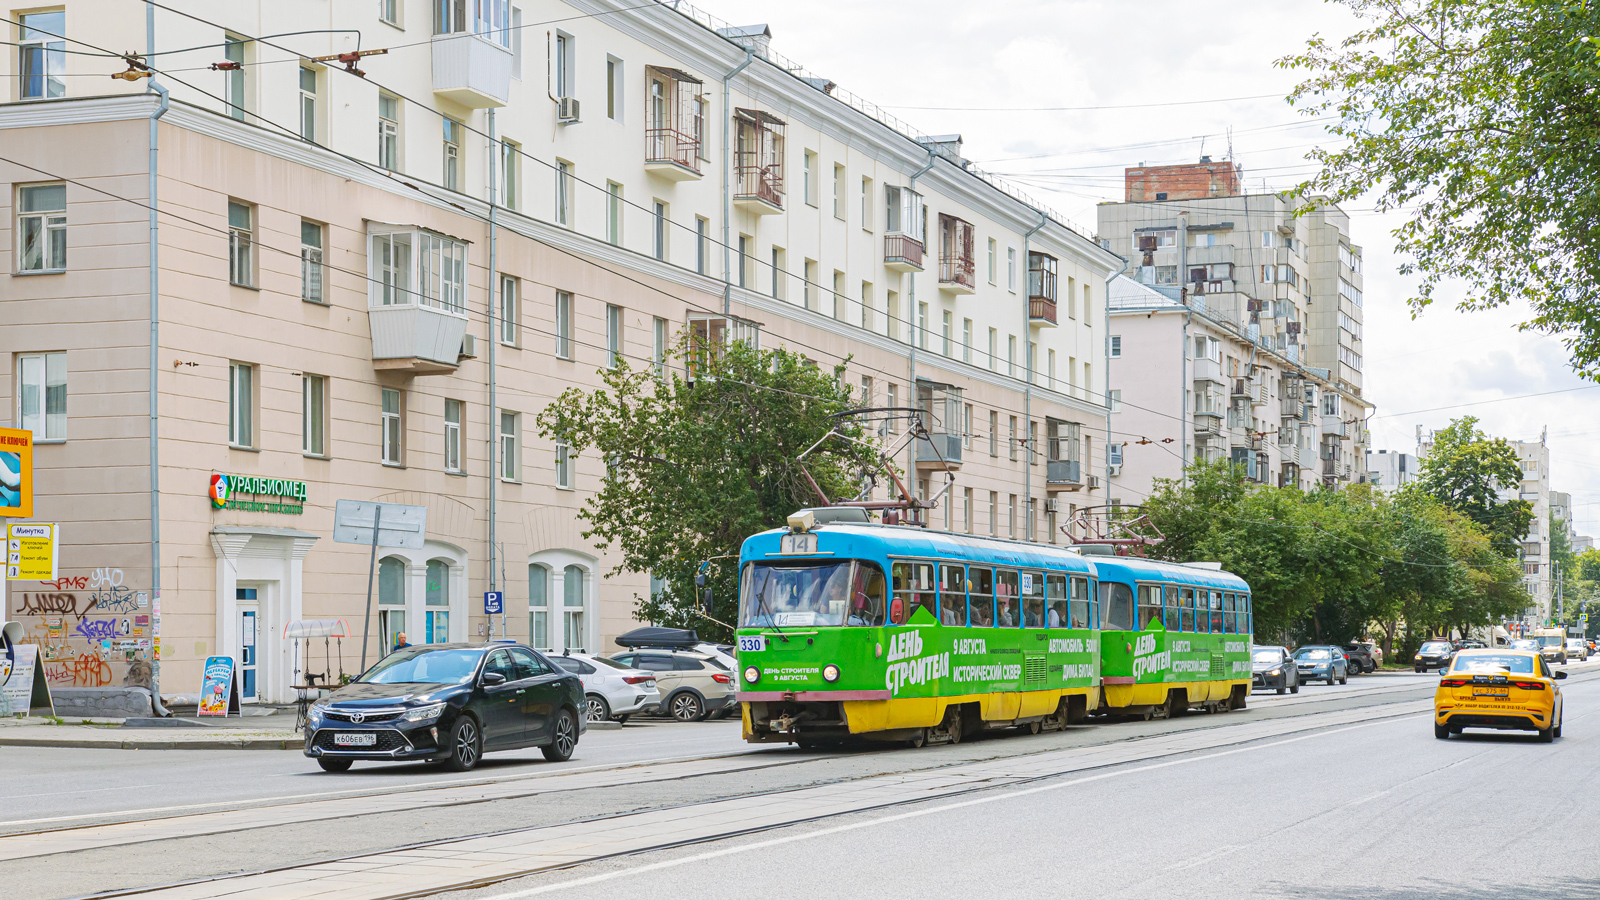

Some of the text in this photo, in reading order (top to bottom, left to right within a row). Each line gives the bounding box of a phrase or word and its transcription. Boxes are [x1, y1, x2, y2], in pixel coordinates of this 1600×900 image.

[7, 436, 28, 446] КЛЮЧЕЙ
[230, 475, 306, 501] УРАЛБИОМЕД
[16, 527, 44, 536] Минутка
[741, 640, 760, 650] 330
[887, 629, 923, 662] ДЕНЬ
[954, 638, 986, 654] 9 АВГУСТА
[1048, 638, 1084, 653] АВТОМОБИЛЬ
[1134, 633, 1156, 657] ДЕНЬ
[886, 652, 950, 696] СТРОИТЕЛЯ
[953, 662, 1021, 682] ИСТОРИЧЕСКИЙ СКВЕР
[1062, 664, 1078, 681] ДИМА
